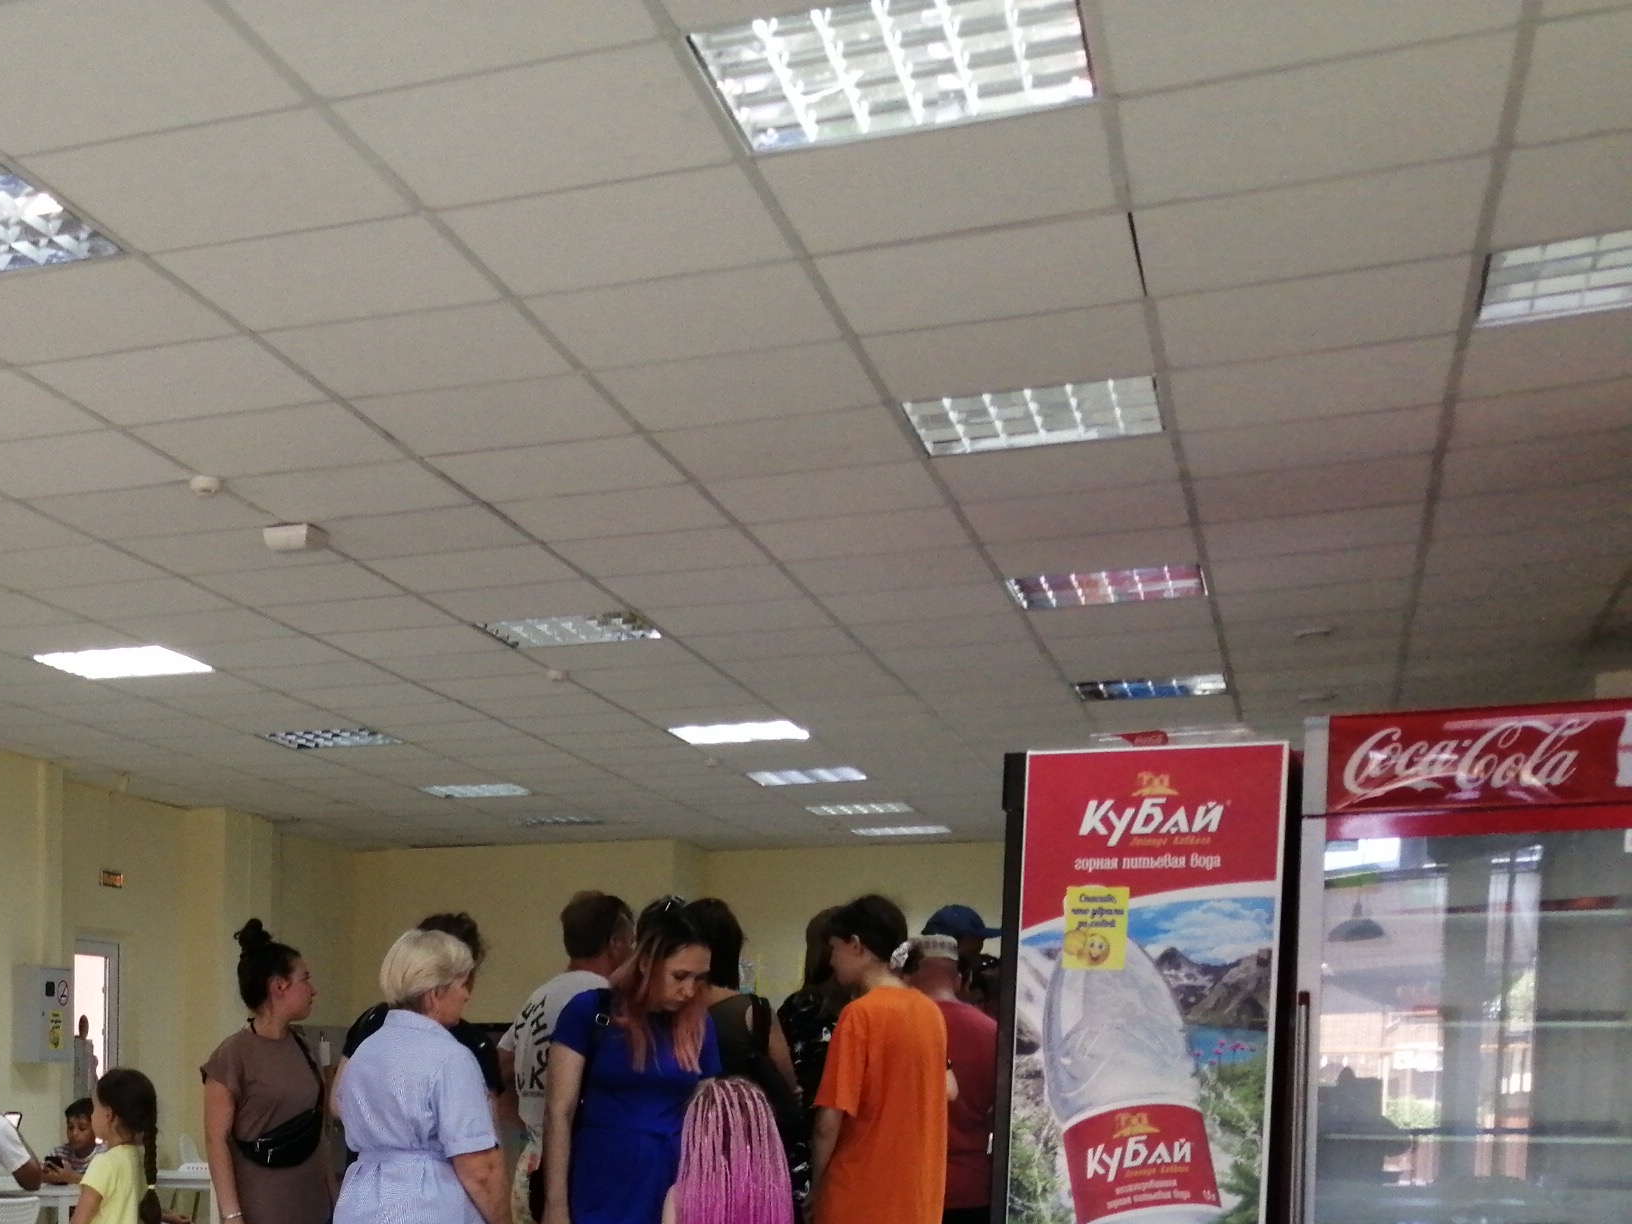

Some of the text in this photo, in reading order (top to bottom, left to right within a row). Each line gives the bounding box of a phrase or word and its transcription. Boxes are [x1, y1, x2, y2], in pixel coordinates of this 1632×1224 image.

[1340, 718, 1597, 802] Coca-Cola
[1074, 852, 1221, 873] горная питьевая вода
